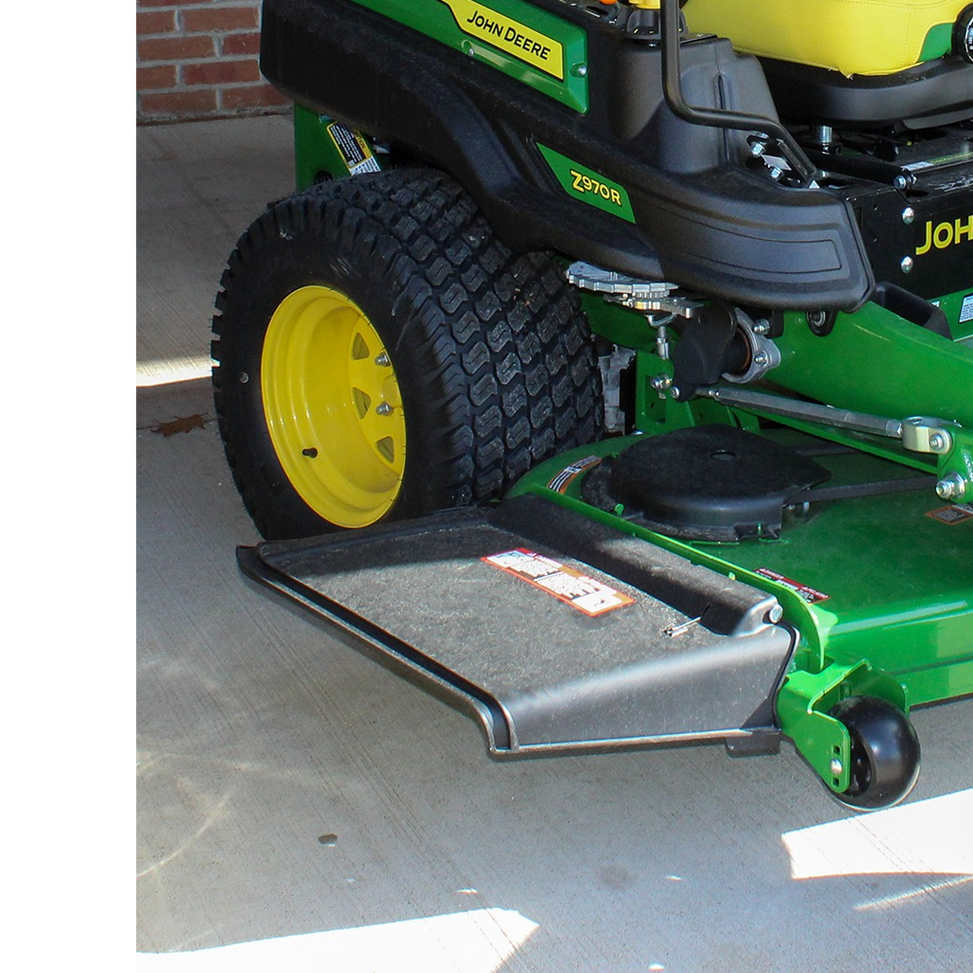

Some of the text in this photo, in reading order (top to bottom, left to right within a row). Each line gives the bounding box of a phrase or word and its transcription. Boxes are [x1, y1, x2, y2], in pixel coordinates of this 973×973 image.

[466, 10, 551, 60] JOHN DEERE
[570, 169, 622, 206] Z970R
